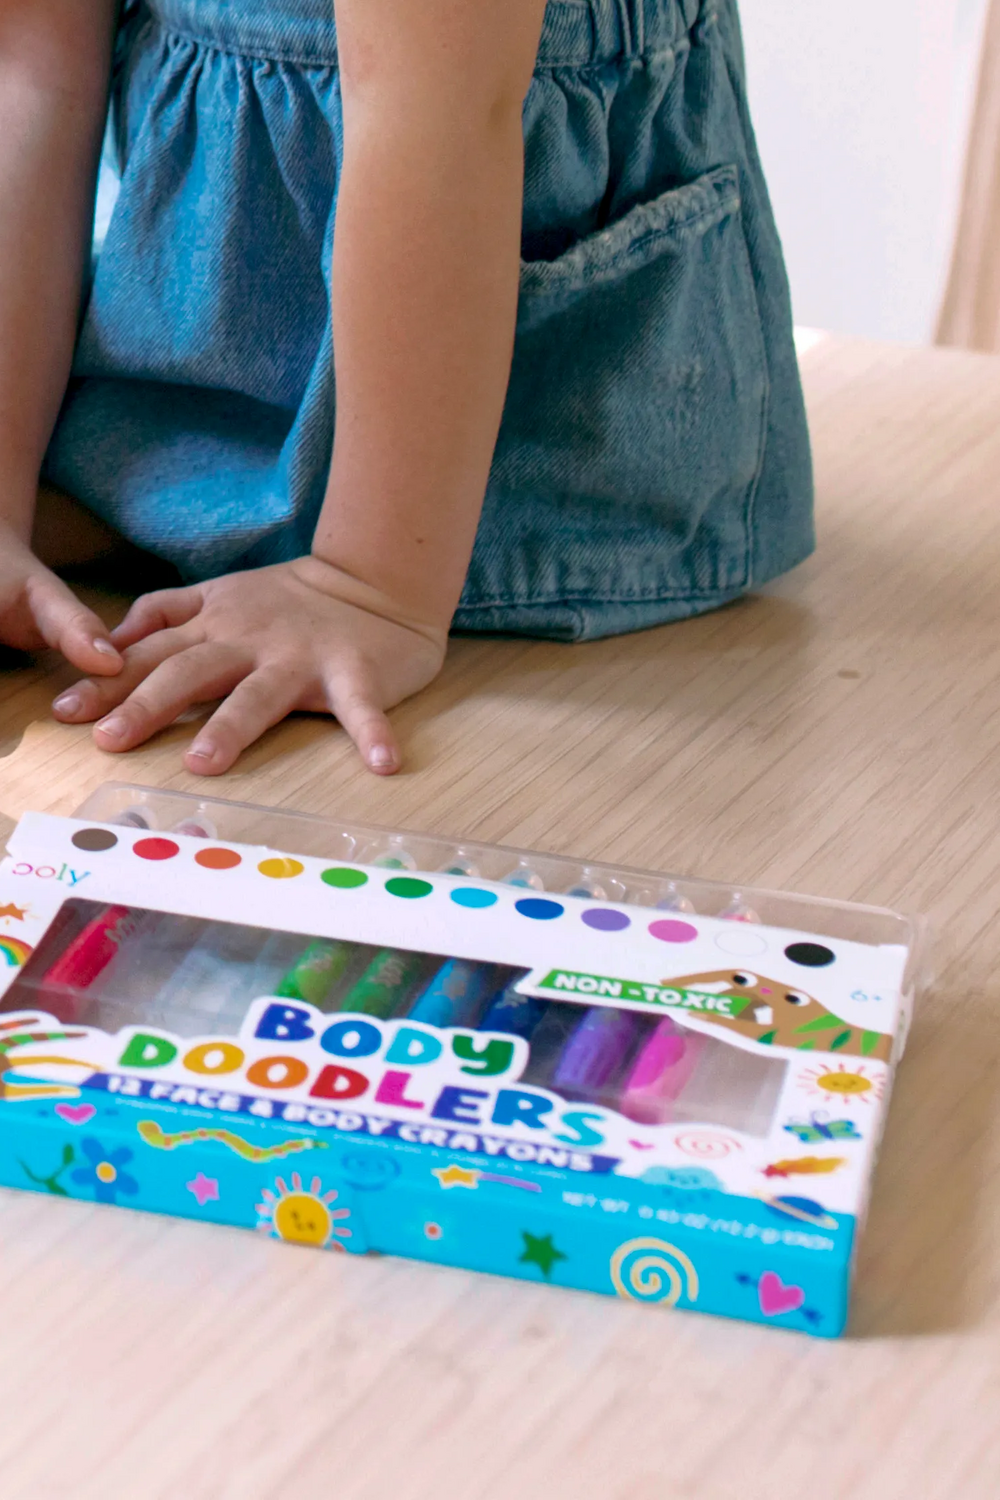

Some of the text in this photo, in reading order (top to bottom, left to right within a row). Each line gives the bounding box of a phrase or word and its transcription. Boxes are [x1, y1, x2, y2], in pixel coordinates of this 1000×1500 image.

[253, 1002, 515, 1077] BODY
[117, 1032, 606, 1147] DOODLERS
[149, 1082, 241, 1112] FACE
[281, 1102, 393, 1136] BODY
[398, 1123, 593, 1172] CRAYONS
